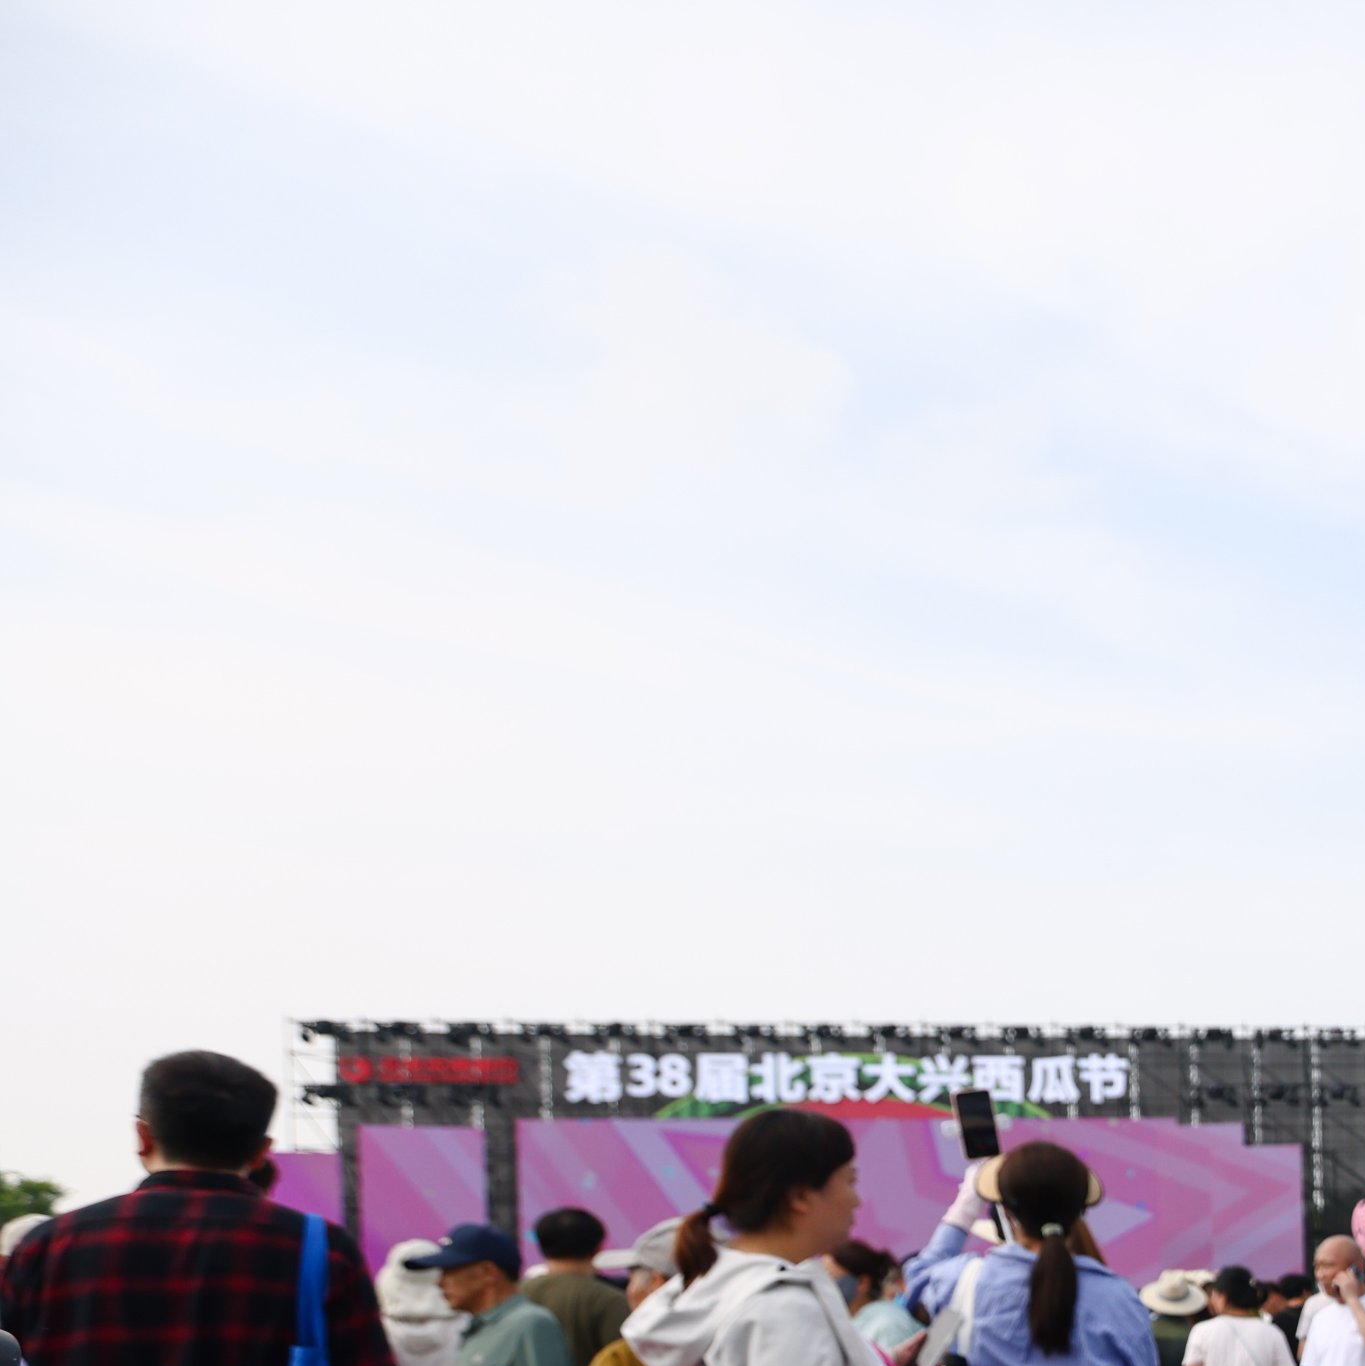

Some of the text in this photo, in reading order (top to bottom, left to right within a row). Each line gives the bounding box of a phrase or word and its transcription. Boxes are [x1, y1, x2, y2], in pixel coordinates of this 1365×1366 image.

[562, 1050, 1130, 1103] 第38届北京大兴西瓜节
